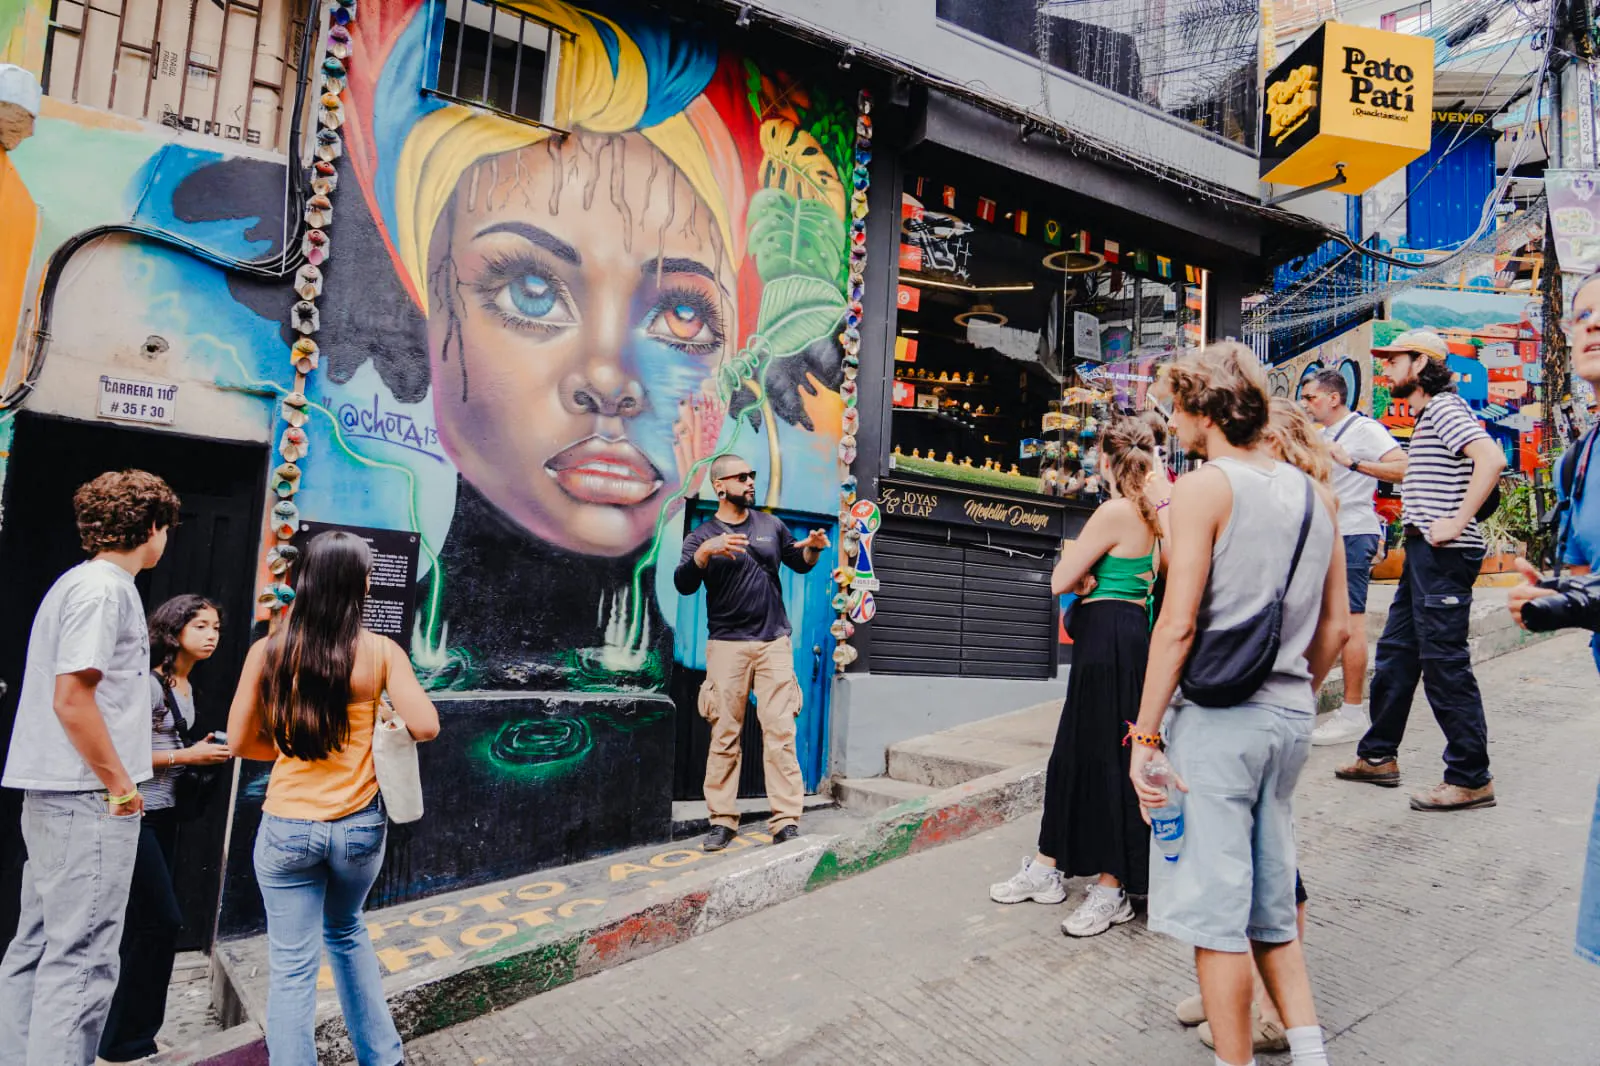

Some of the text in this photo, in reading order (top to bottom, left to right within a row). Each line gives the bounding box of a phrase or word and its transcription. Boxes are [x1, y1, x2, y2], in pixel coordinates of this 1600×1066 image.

[1342, 46, 1414, 83] Pato
[1349, 76, 1415, 112] Patí
[104, 381, 174, 401] CARRERA 110
[110, 402, 164, 418] # 35 F 30
[902, 491, 938, 507] JOYAS
[901, 503, 933, 517] CLAP
